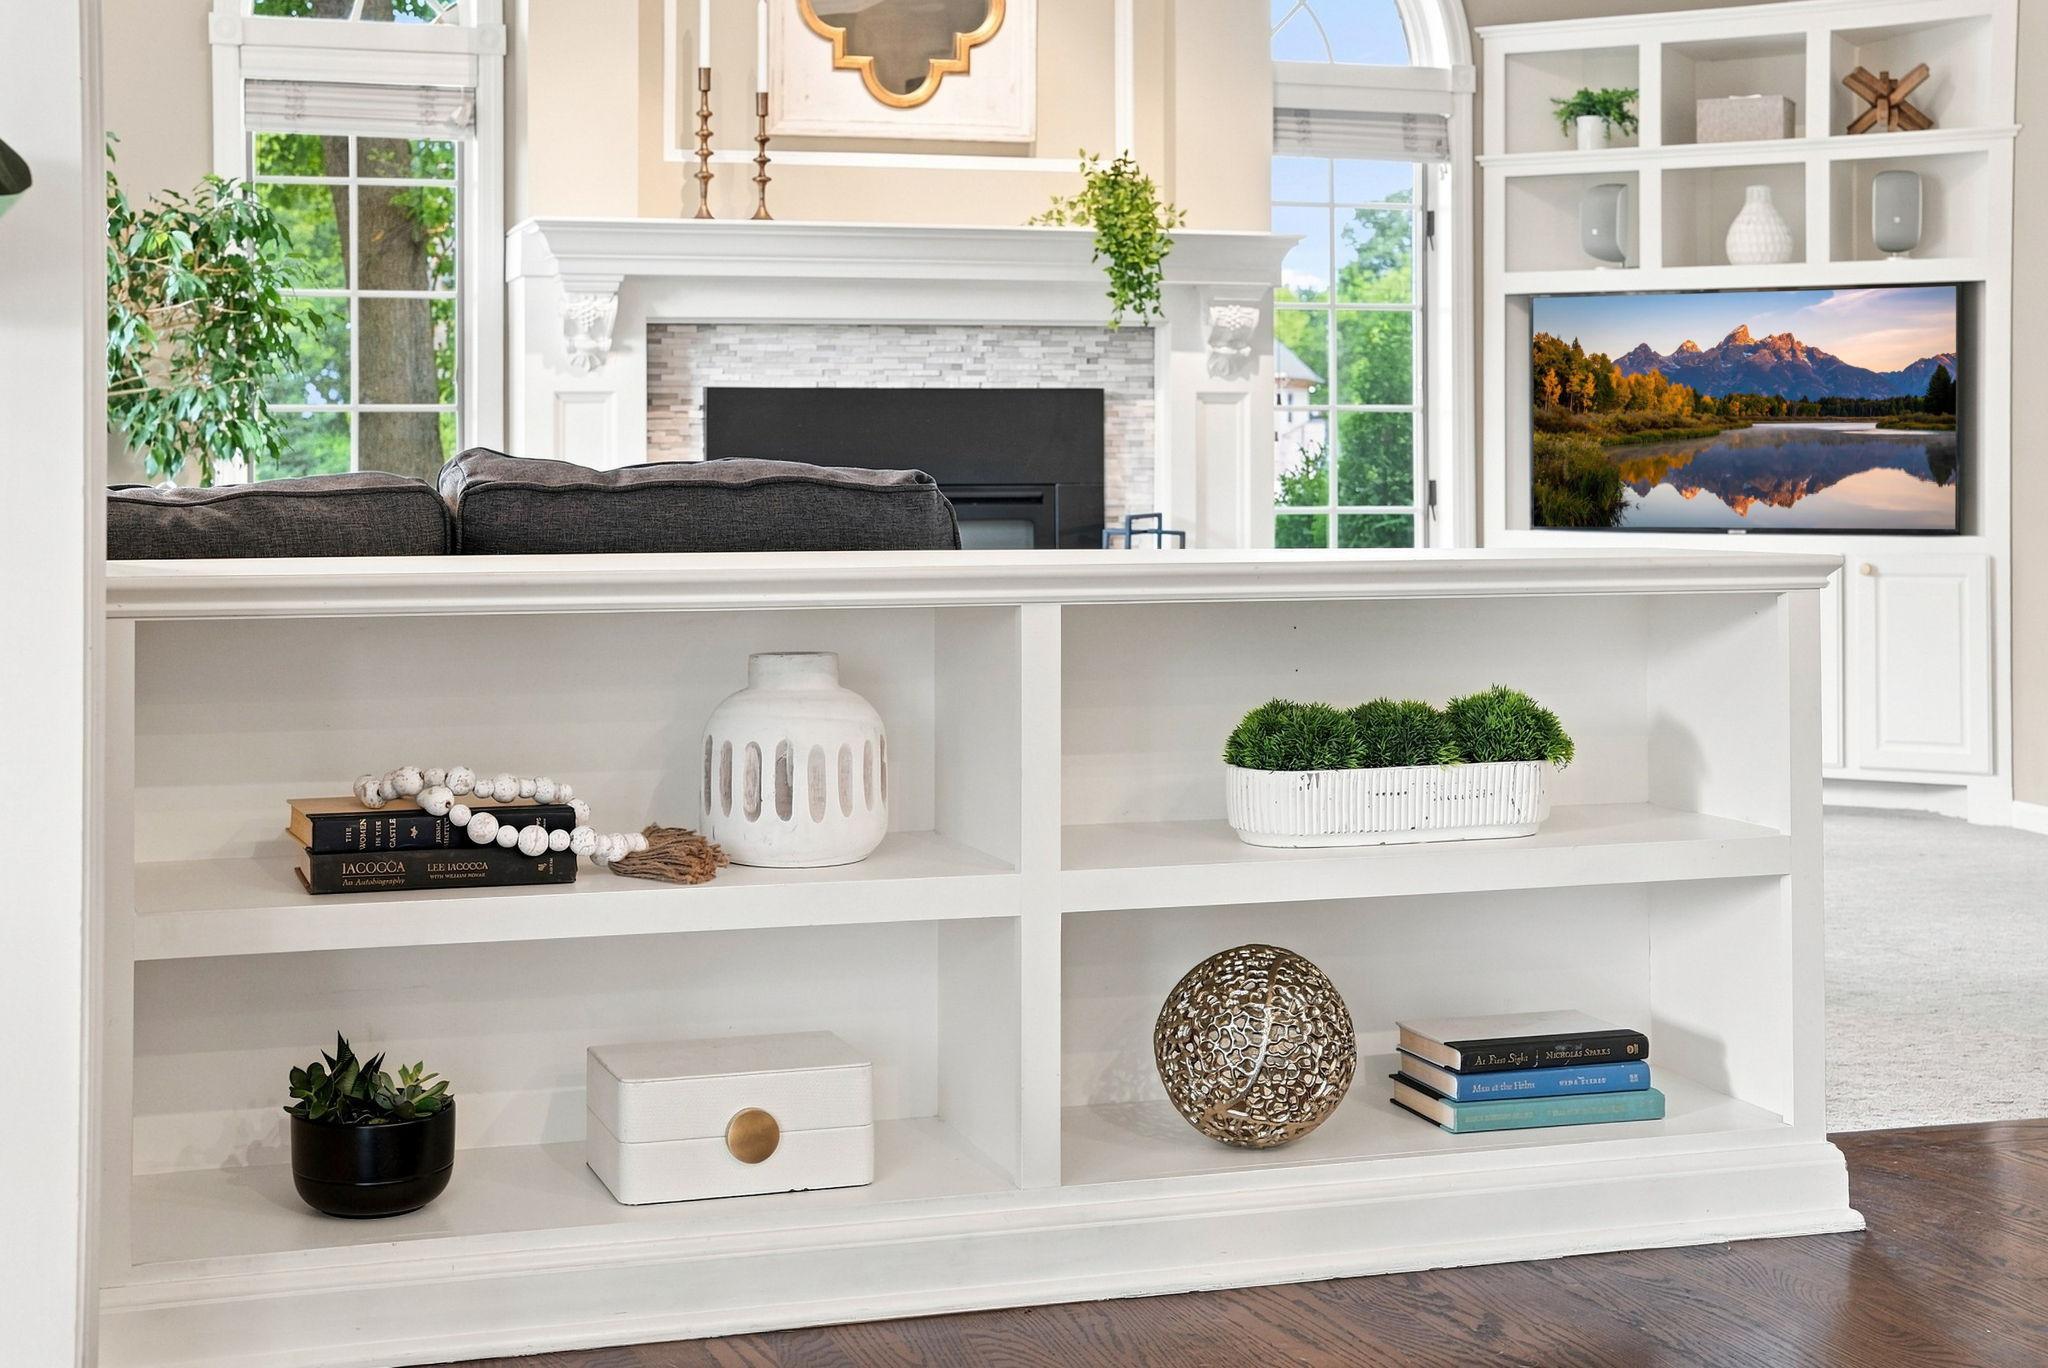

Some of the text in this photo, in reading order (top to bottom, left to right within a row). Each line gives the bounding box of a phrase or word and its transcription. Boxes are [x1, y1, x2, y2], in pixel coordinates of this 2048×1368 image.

[359, 818, 367, 850] WOMEN
[388, 818, 397, 848] CASTLE
[342, 860, 406, 874] IACOCCA
[427, 861, 489, 872] LEE IACOCCA
[342, 876, 406, 887] An Autobiography
[1474, 1052, 1529, 1066] At First Sight
[1472, 1084, 1491, 1093] Man
[1491, 1084, 1499, 1092] at
[1500, 1081, 1513, 1091] the
